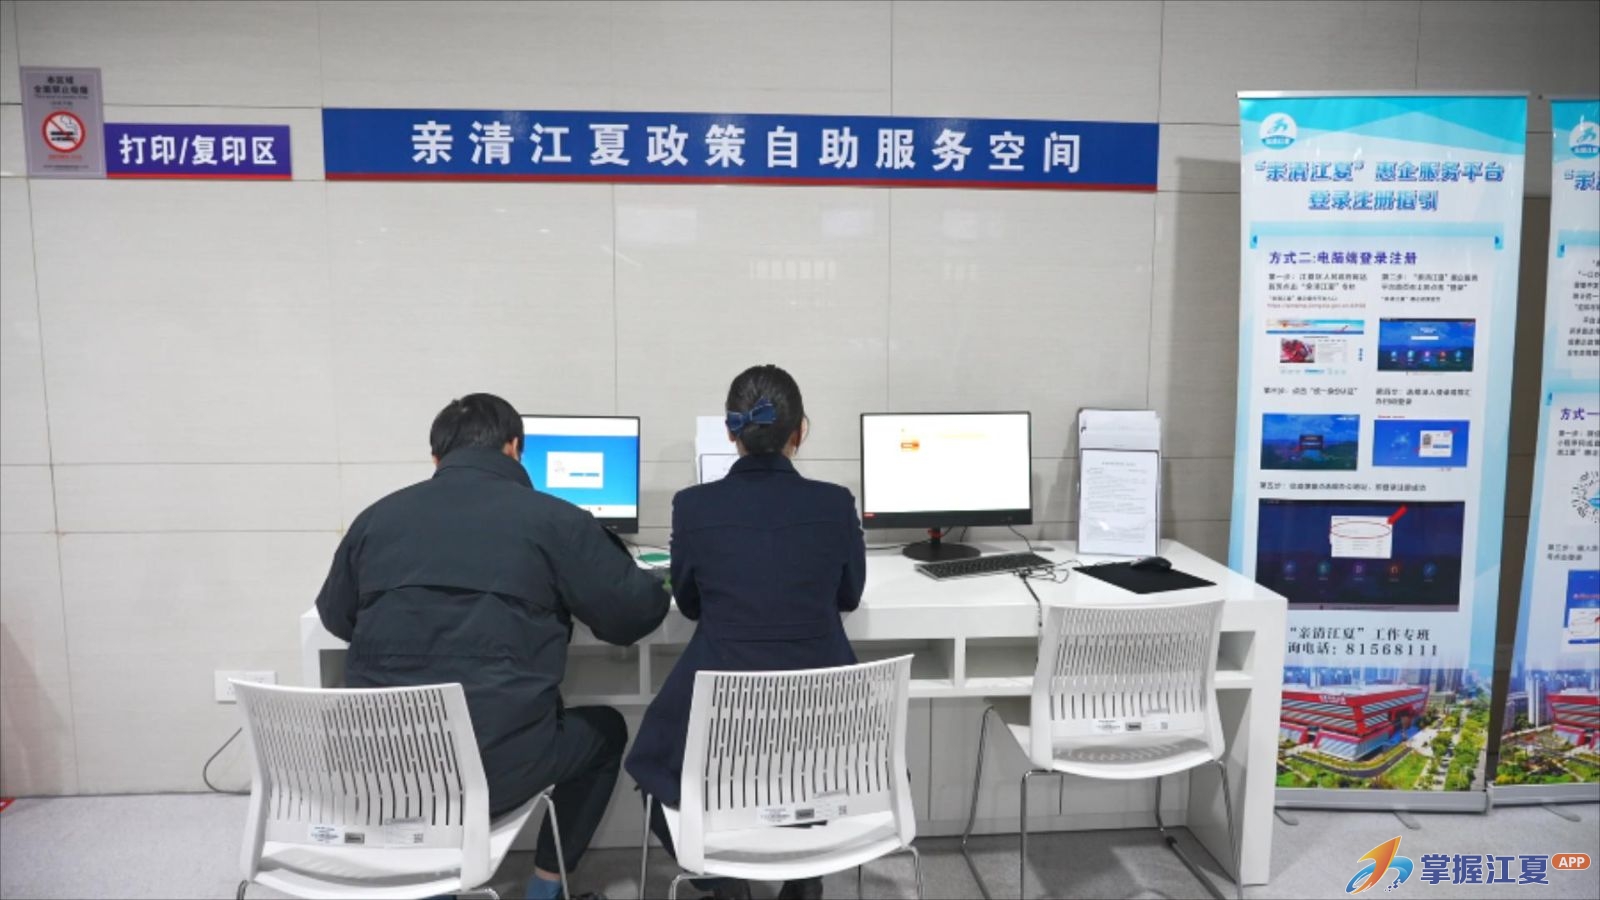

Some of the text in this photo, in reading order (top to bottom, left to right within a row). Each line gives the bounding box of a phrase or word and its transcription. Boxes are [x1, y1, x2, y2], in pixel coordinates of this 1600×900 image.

[119, 133, 277, 166] 打印/复印区
[411, 120, 1083, 174] 亲清江夏政策自助服务空间
